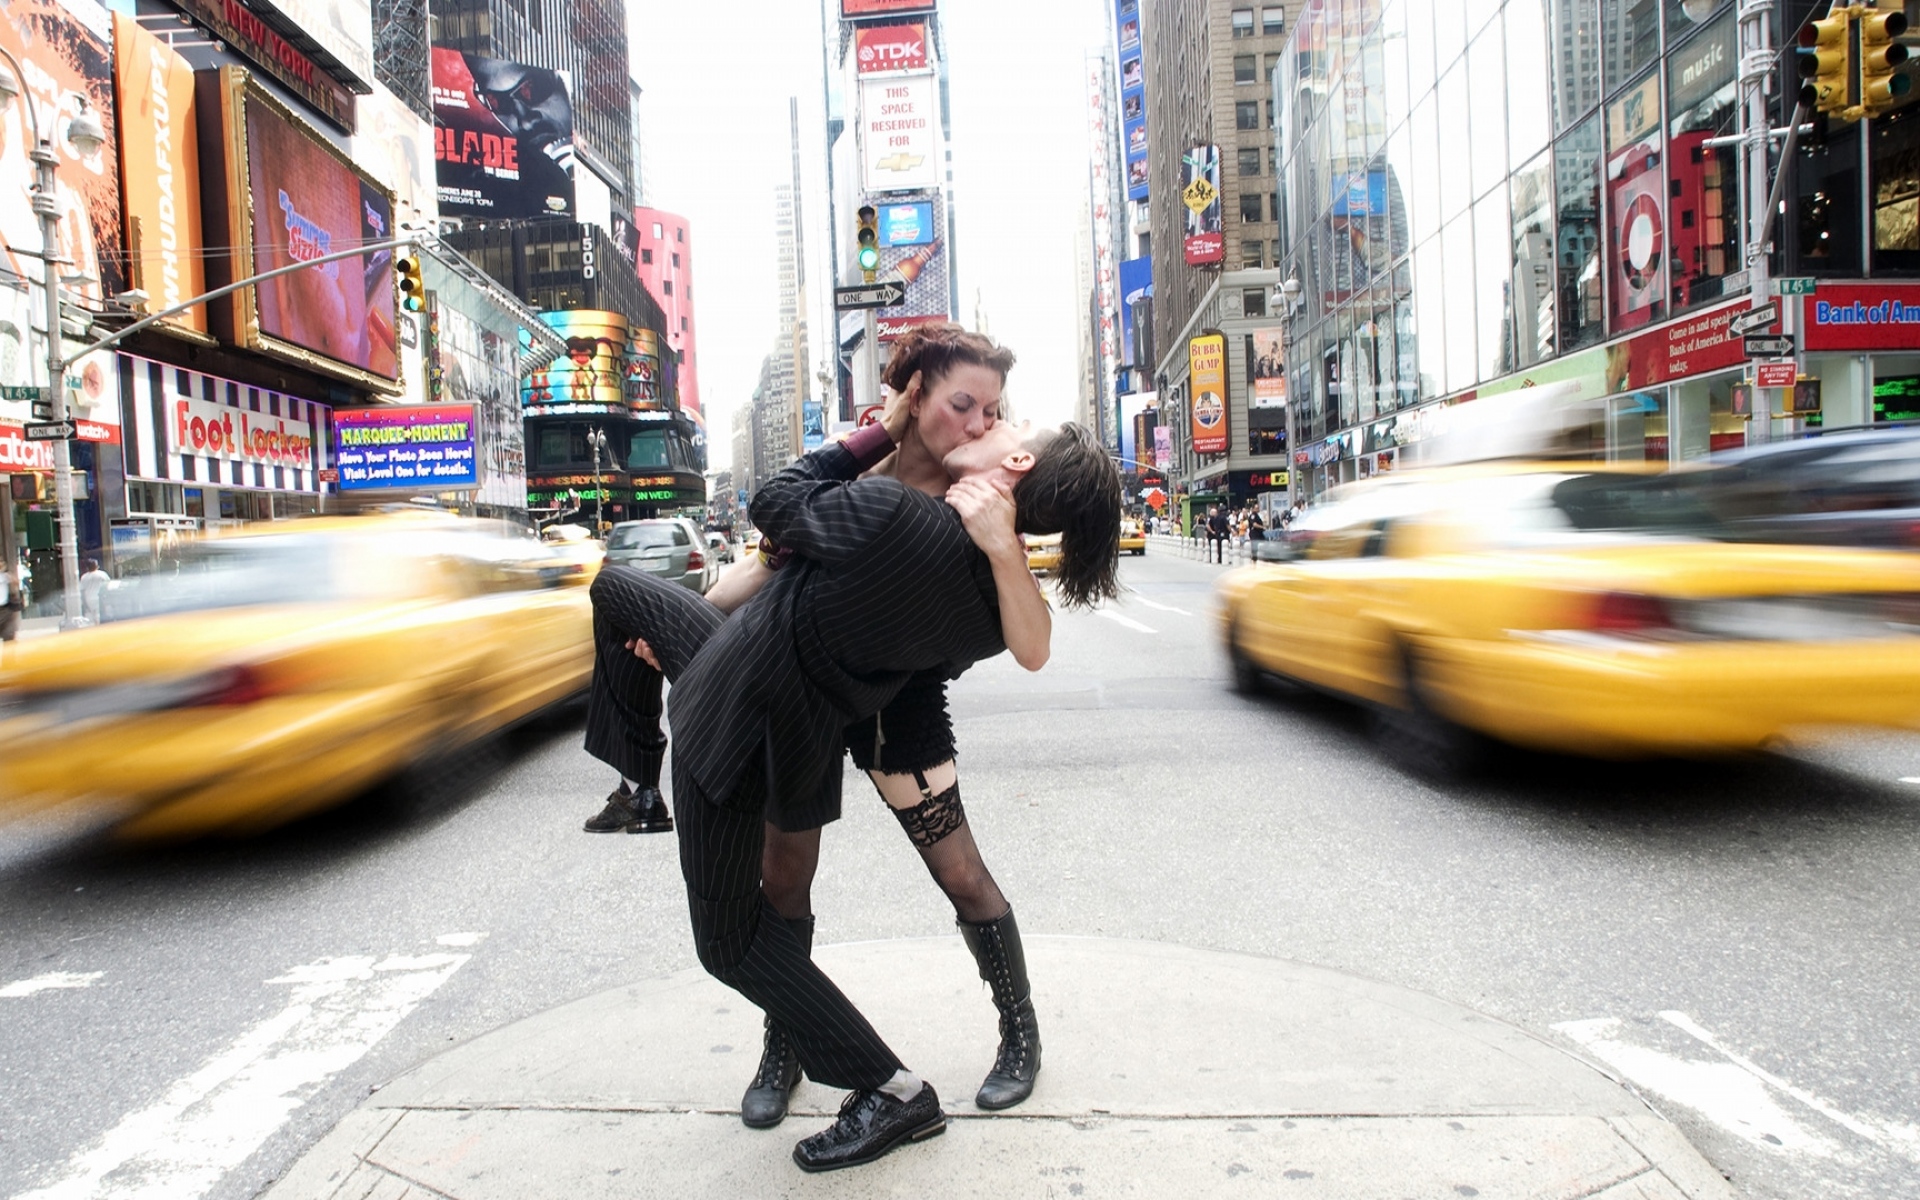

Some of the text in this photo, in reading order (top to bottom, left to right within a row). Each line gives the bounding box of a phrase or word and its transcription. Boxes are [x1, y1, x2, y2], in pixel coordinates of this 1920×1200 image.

[224, 0, 314, 86] NEW YORK
[872, 41, 922, 60] TDK
[1682, 42, 1724, 86] music
[886, 87, 909, 98] THIS
[881, 103, 914, 115] SPACE
[872, 118, 926, 132] RESERVED
[434, 127, 519, 171] BLADE
[889, 136, 910, 147] FOR
[582, 223, 595, 279] 1500
[1782, 280, 1790, 293] W
[1792, 280, 1804, 293] 45
[843, 288, 896, 304] ONE WAY
[1816, 300, 1867, 325] Bank
[1868, 299, 1889, 324] of
[1669, 328, 1687, 340] Come
[1688, 323, 1696, 332] in
[1696, 318, 1709, 330] and
[1711, 310, 1730, 330] speak
[1734, 310, 1771, 330] ONE WAY
[1191, 343, 1221, 357] BUBBA
[1669, 344, 1686, 357] Bank
[1687, 340, 1694, 352] of
[1695, 333, 1724, 349] America
[1750, 341, 1789, 351] ONE WAY
[1194, 358, 1220, 371] GUMP
[1669, 361, 1688, 374] today.
[1769, 365, 1793, 373] STANDING
[1763, 371, 1789, 379] ANYTIME
[4, 388, 12, 399] W
[16, 388, 27, 399] 45
[33, 427, 69, 436] ONE WAY
[77, 425, 105, 438] watch
[176, 400, 311, 463] Foot Locker
[340, 422, 468, 446] MARQUEE MOMENT
[0, 432, 46, 468] atch
[340, 451, 363, 465] Have
[366, 450, 387, 465] Your
[389, 448, 417, 462] Photo
[343, 467, 367, 480] Visit
[368, 464, 394, 480] Level
[395, 465, 415, 477] One
[416, 463, 431, 477] for
[554, 489, 604, 500] MAAGER
